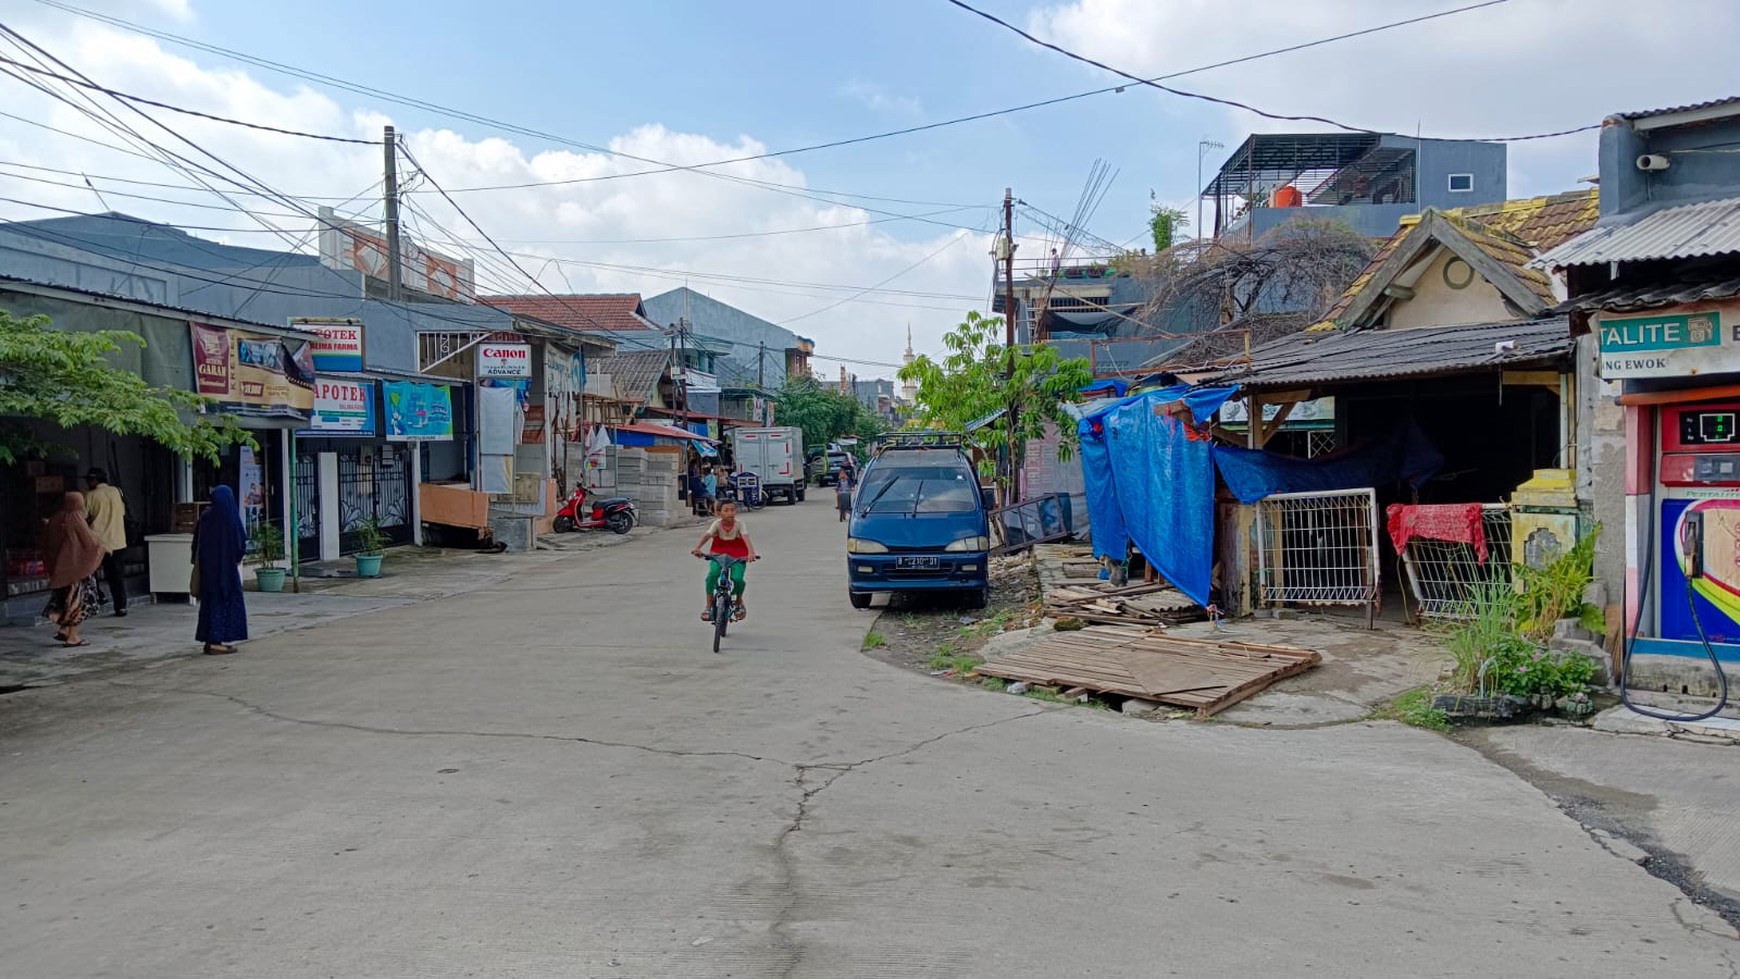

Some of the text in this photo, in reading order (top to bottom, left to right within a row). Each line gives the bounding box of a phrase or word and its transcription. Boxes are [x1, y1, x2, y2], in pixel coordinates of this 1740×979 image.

[309, 328, 357, 340] POTEK
[483, 348, 526, 359] Canon
[1602, 358, 1665, 371] NG EWOK
[314, 384, 366, 401] APOTEK
